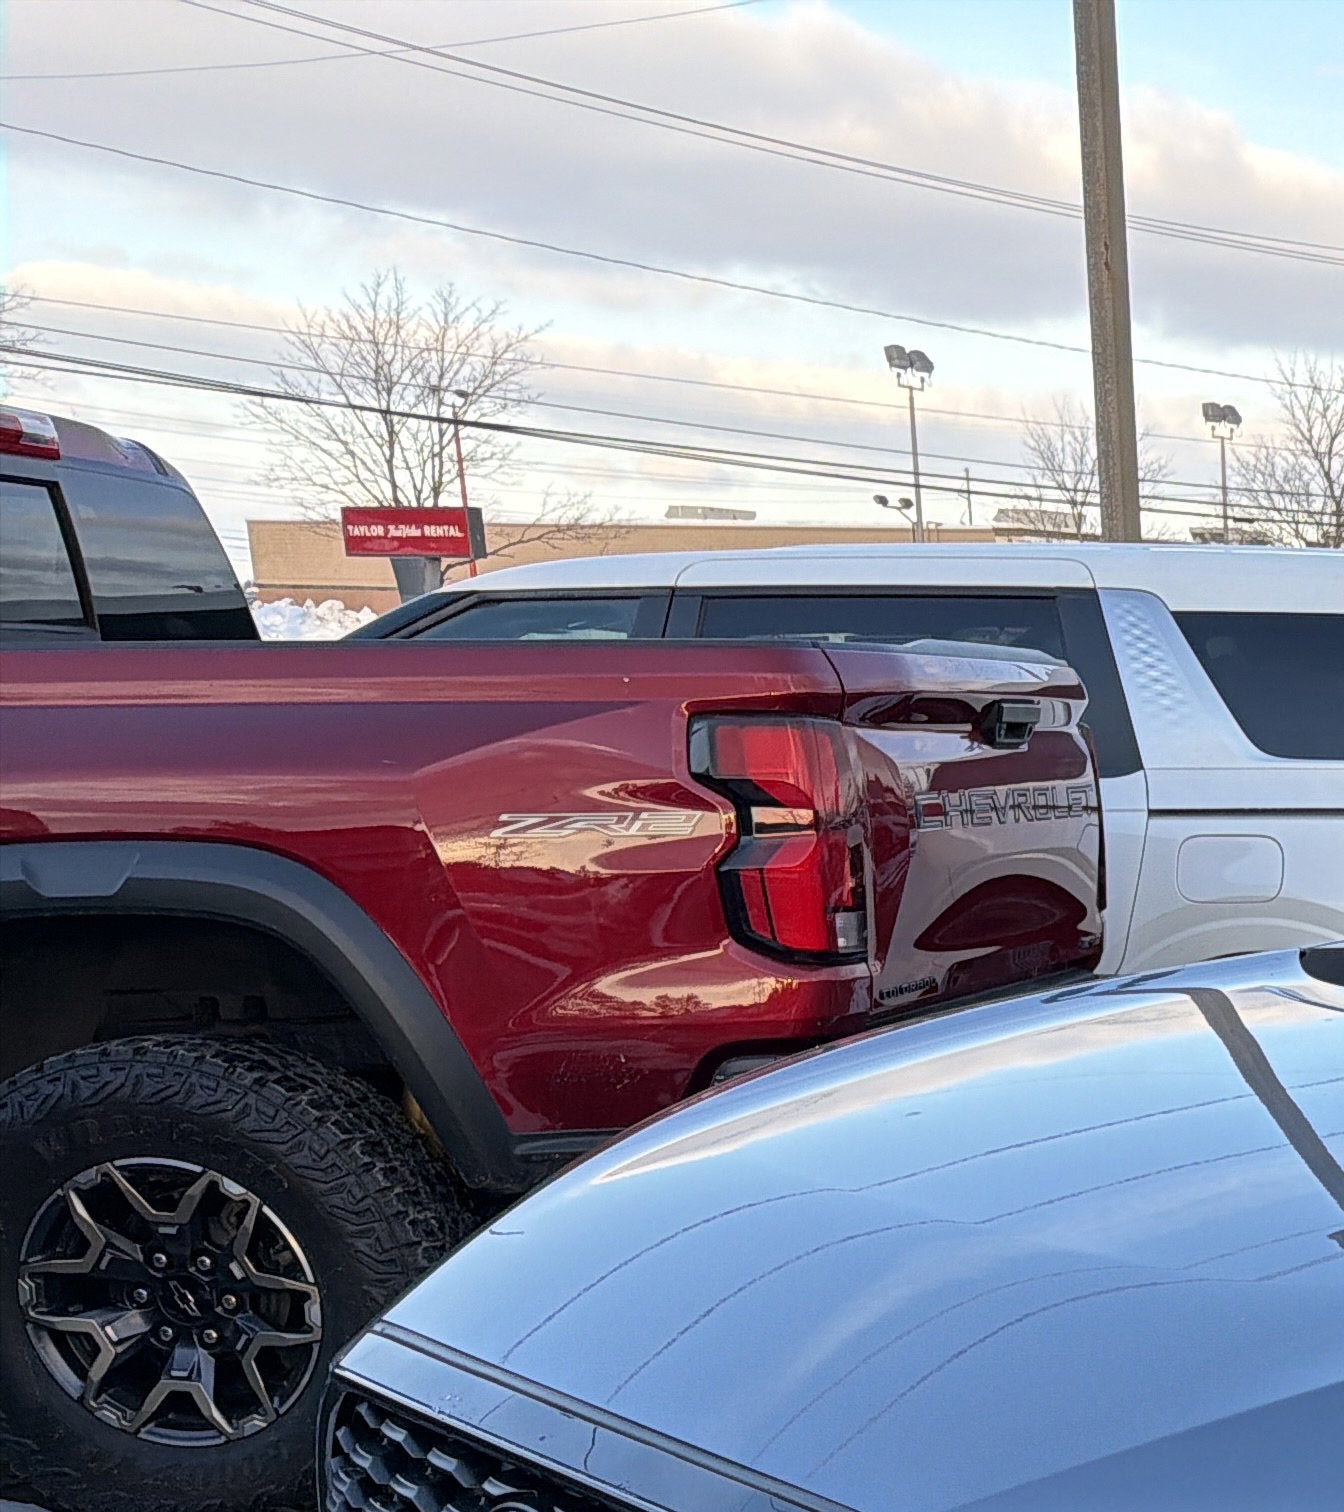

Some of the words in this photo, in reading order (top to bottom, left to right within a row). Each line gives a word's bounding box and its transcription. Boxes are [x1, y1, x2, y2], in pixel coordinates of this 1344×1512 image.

[347, 525, 384, 537] TAYLOR
[423, 525, 464, 538] RENTAL
[913, 783, 1093, 829] CHEVROLET
[490, 811, 704, 838] ZR2
